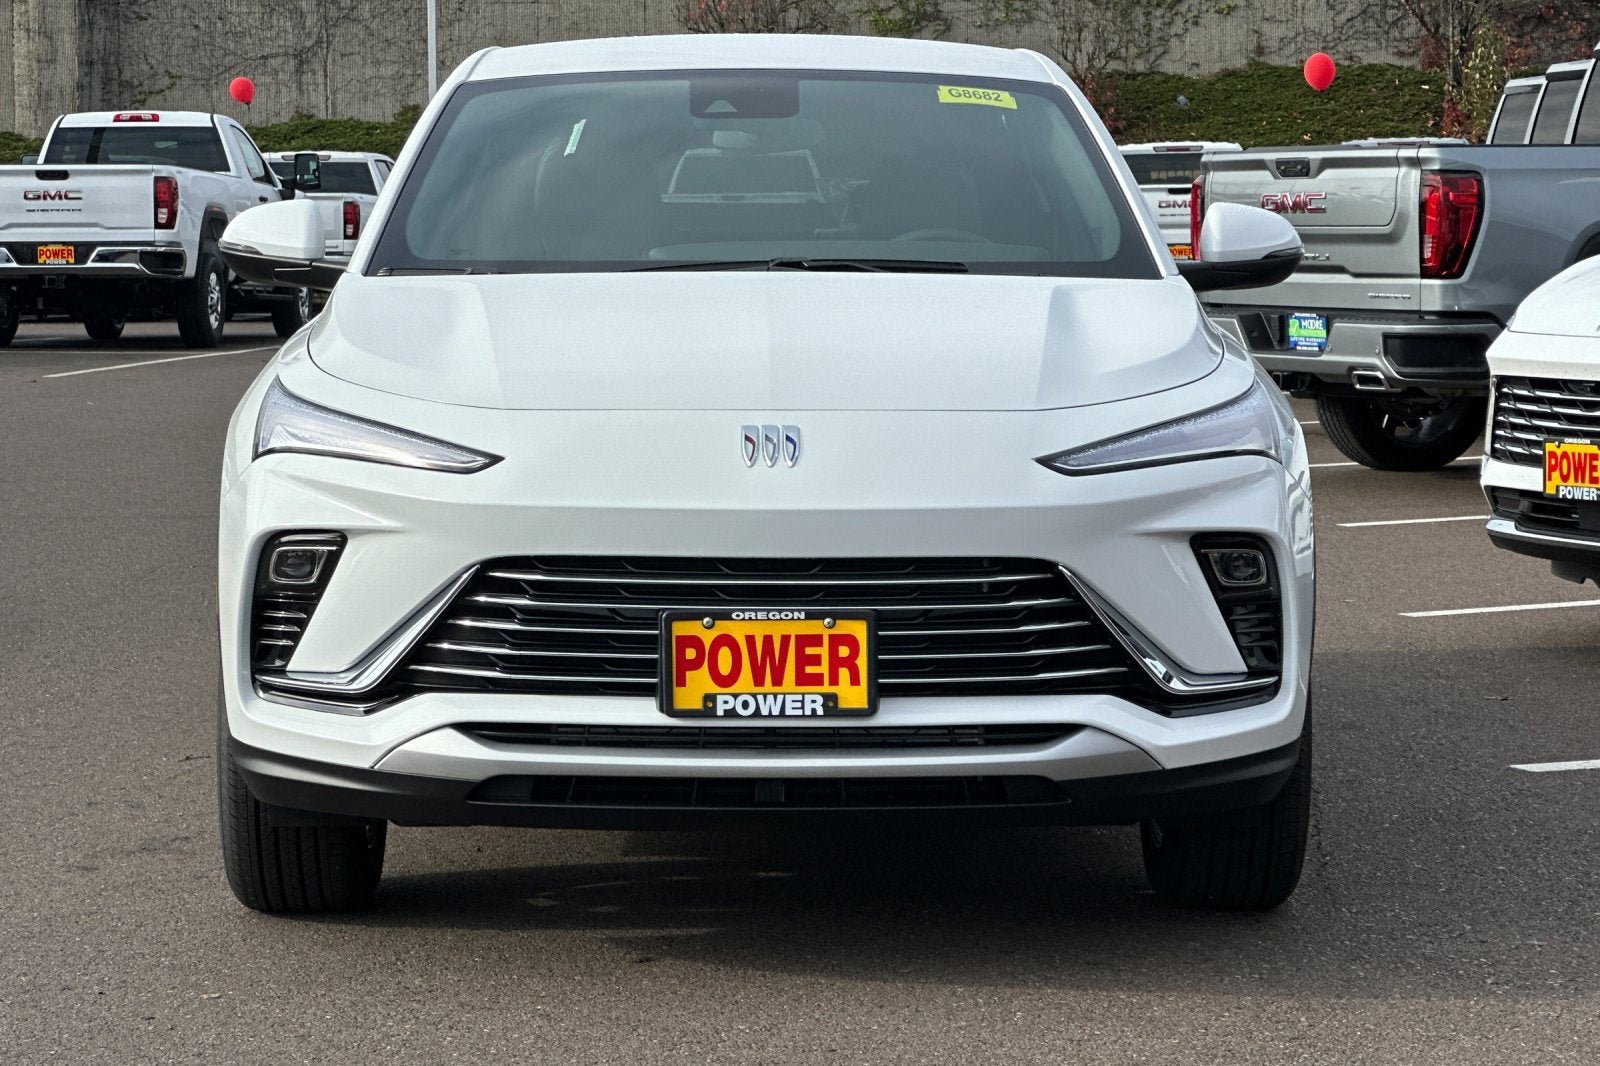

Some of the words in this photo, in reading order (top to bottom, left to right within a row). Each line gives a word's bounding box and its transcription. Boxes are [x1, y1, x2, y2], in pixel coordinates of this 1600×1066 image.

[948, 88, 1003, 102] G8682
[23, 190, 83, 201] GMC
[1158, 200, 1192, 209] GM
[1261, 192, 1327, 214] GMC
[38, 248, 74, 260] POWER
[1300, 318, 1324, 330] MOORE
[1547, 451, 1599, 485] POWE
[1559, 486, 1598, 501] POWER
[731, 610, 806, 621] OREGON
[675, 633, 861, 688] POWER
[715, 693, 825, 717] POWER
